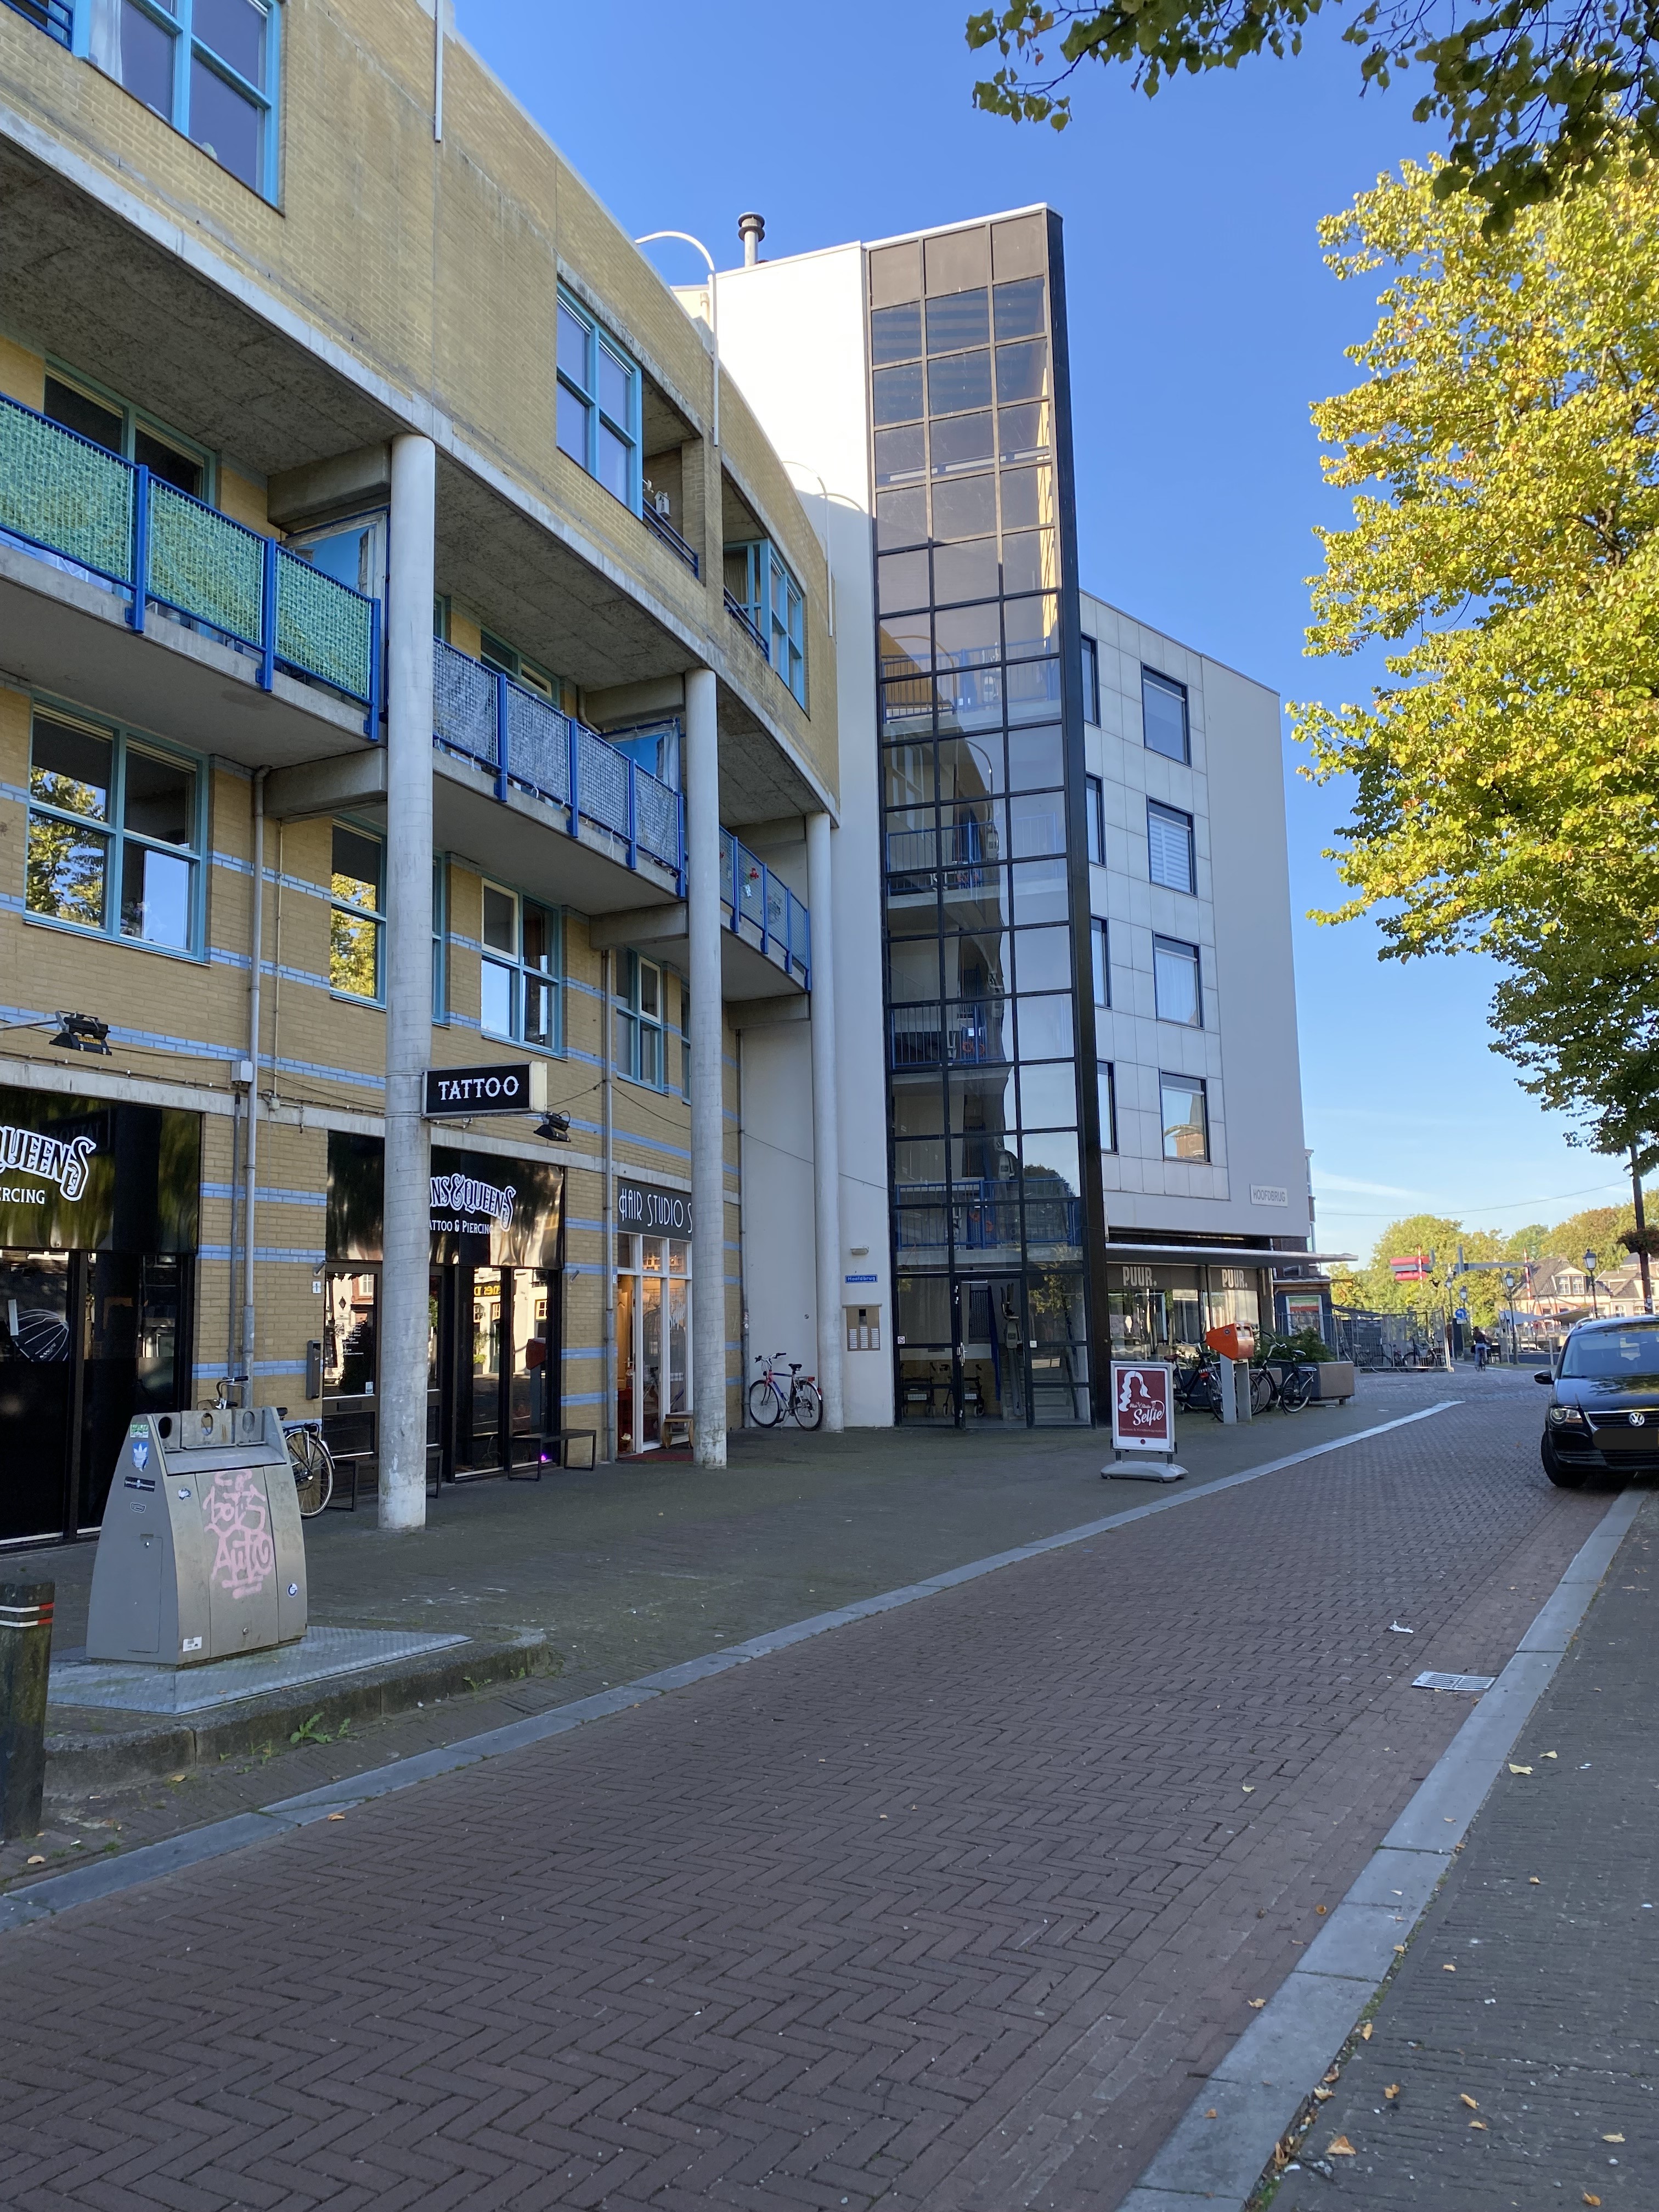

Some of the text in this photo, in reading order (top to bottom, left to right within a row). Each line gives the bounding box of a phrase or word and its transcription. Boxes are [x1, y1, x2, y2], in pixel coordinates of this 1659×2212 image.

[438, 1076, 519, 1100] TATTOO
[0, 1187, 45, 1205] RCING
[1253, 1189, 1285, 1202] HOOFDBRUG
[619, 1188, 643, 1222] HAIR
[647, 1194, 684, 1228] STUDIO
[455, 1219, 460, 1232] &
[1122, 1266, 1157, 1286] PUUR.
[1221, 1269, 1248, 1288] PUUR.
[1133, 1404, 1165, 1426] Selfie
